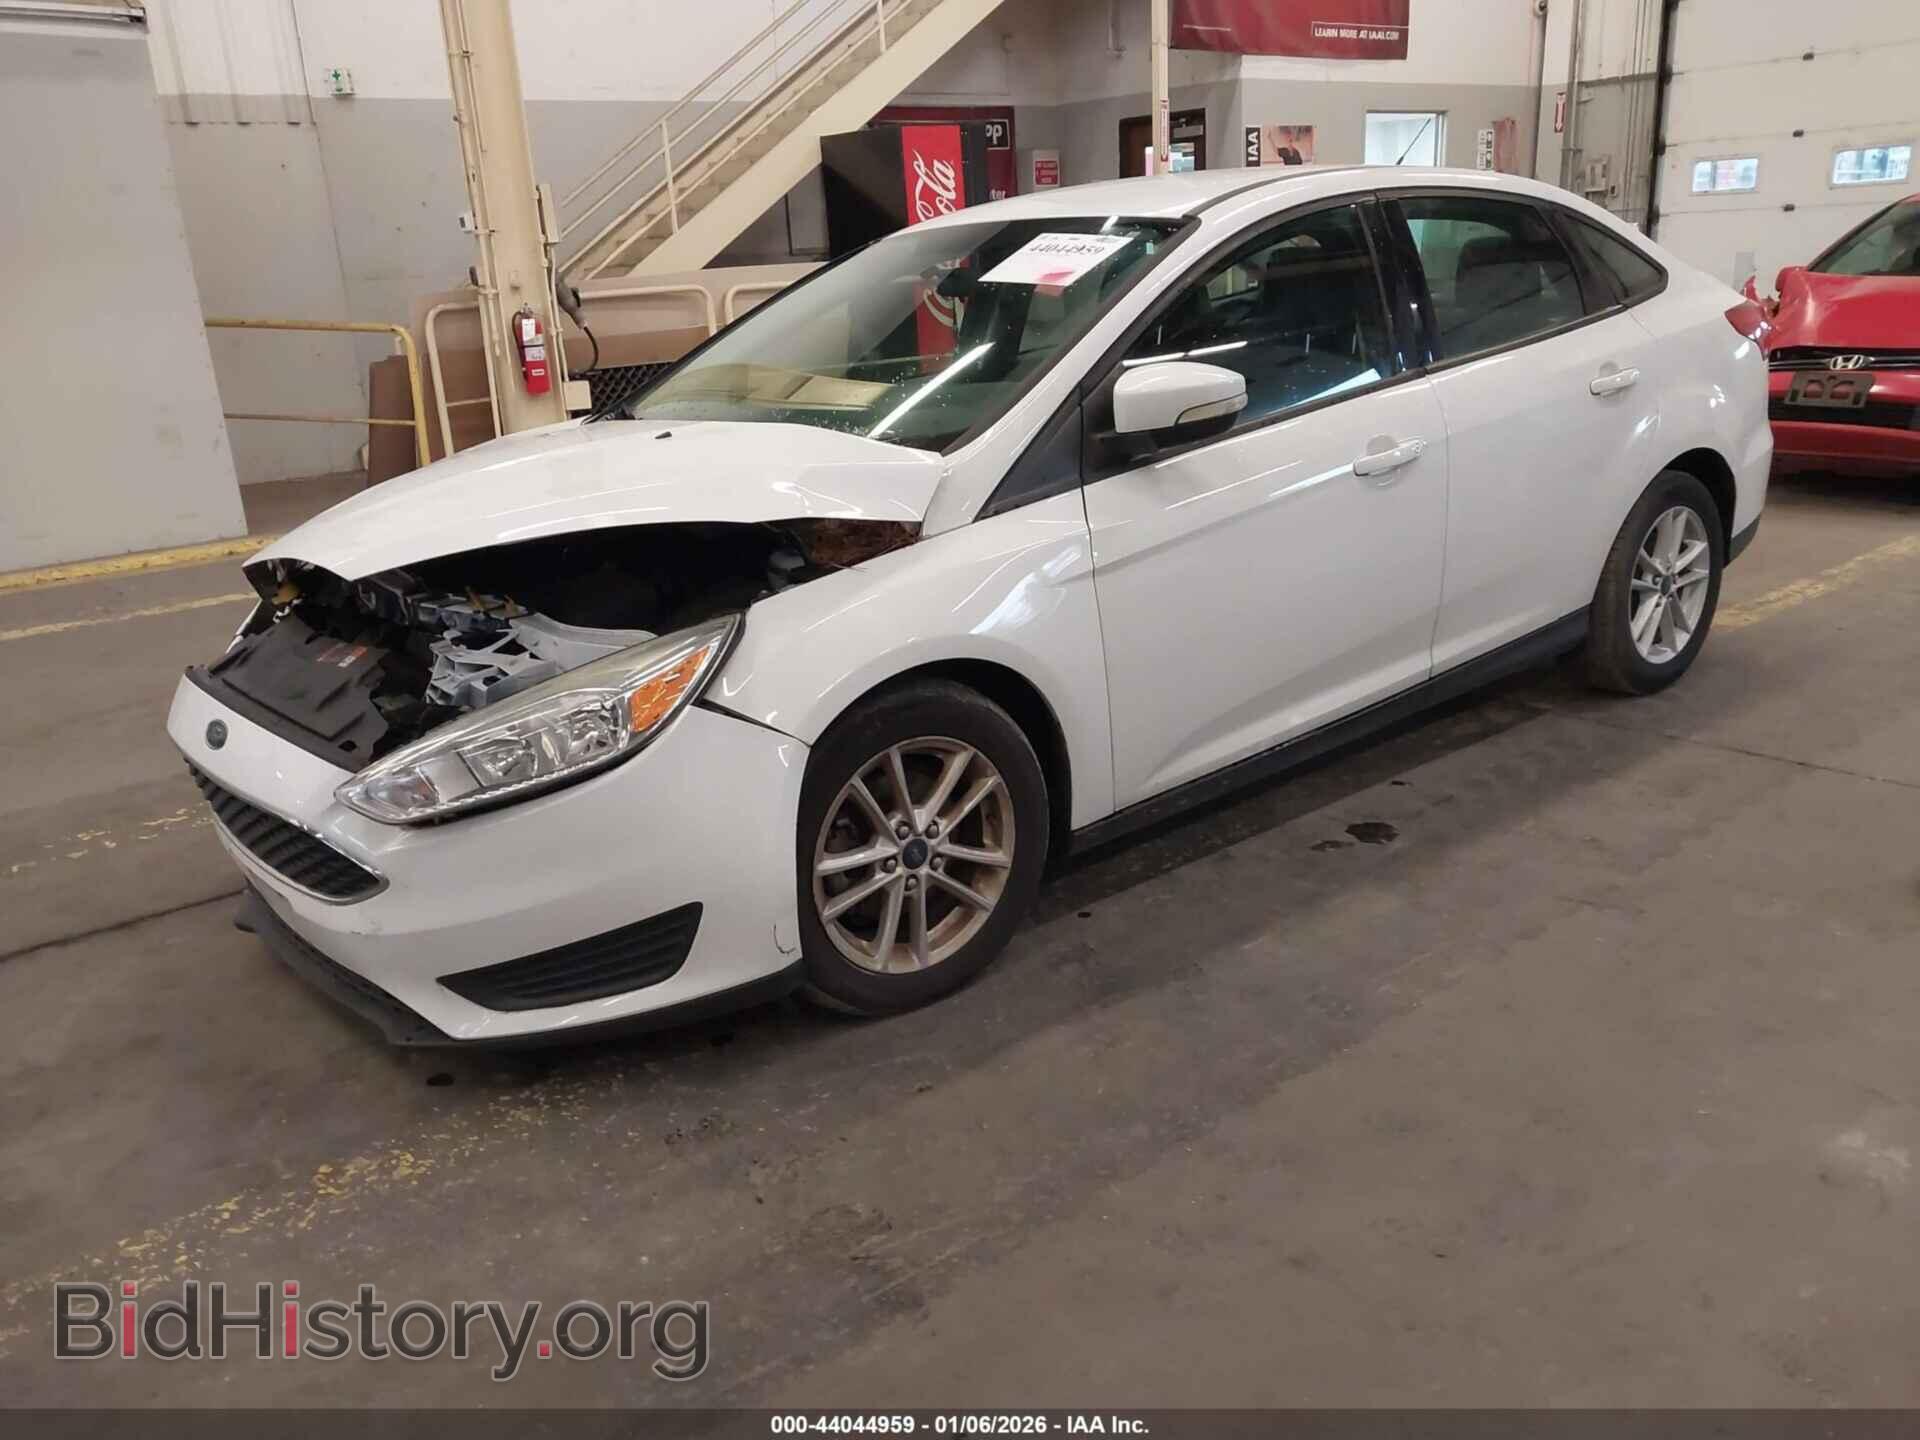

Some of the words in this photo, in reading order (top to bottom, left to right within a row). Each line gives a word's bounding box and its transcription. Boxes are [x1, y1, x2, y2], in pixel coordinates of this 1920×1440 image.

[1314, 27, 1338, 38] LEARN
[1359, 29, 1368, 40] AT
[1247, 130, 1260, 162] IAA
